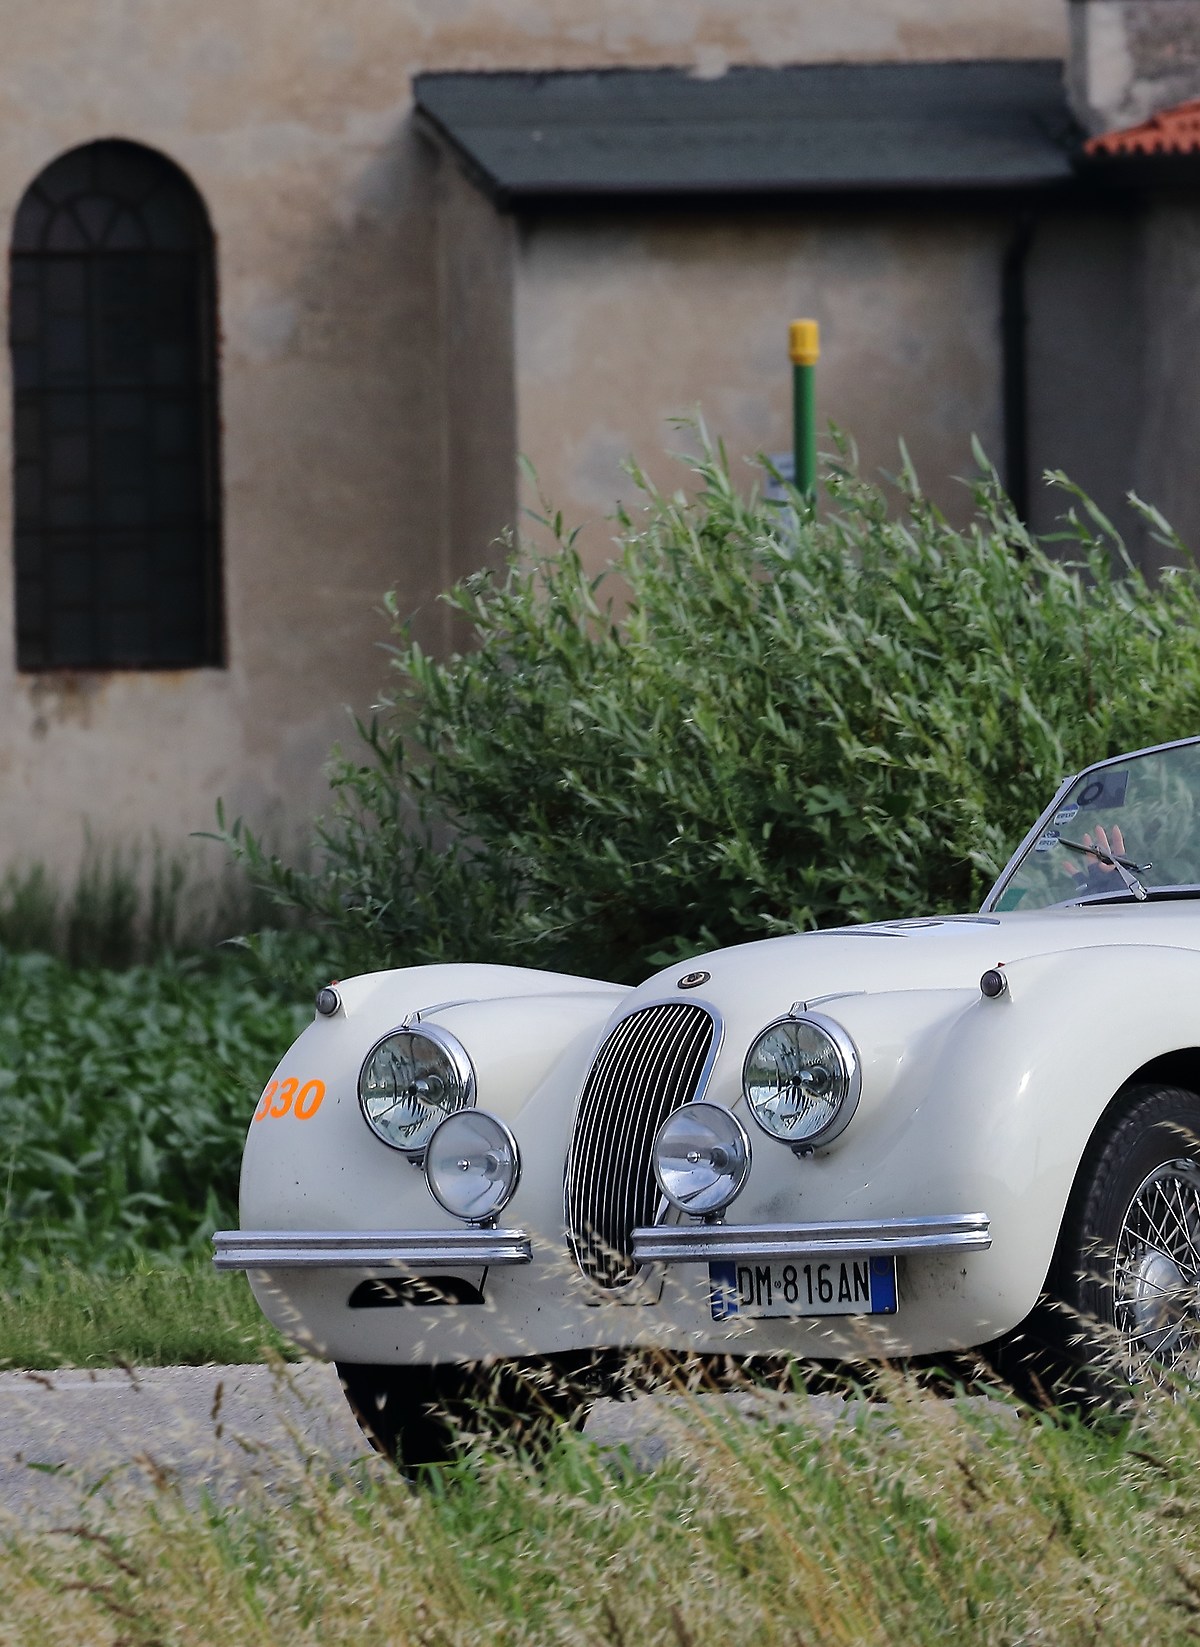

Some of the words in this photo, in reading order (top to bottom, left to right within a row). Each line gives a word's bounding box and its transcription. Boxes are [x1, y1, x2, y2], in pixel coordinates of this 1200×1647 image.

[255, 1077, 326, 1122] 330
[737, 1265, 773, 1306] DM
[782, 1262, 870, 1304] 816AN
